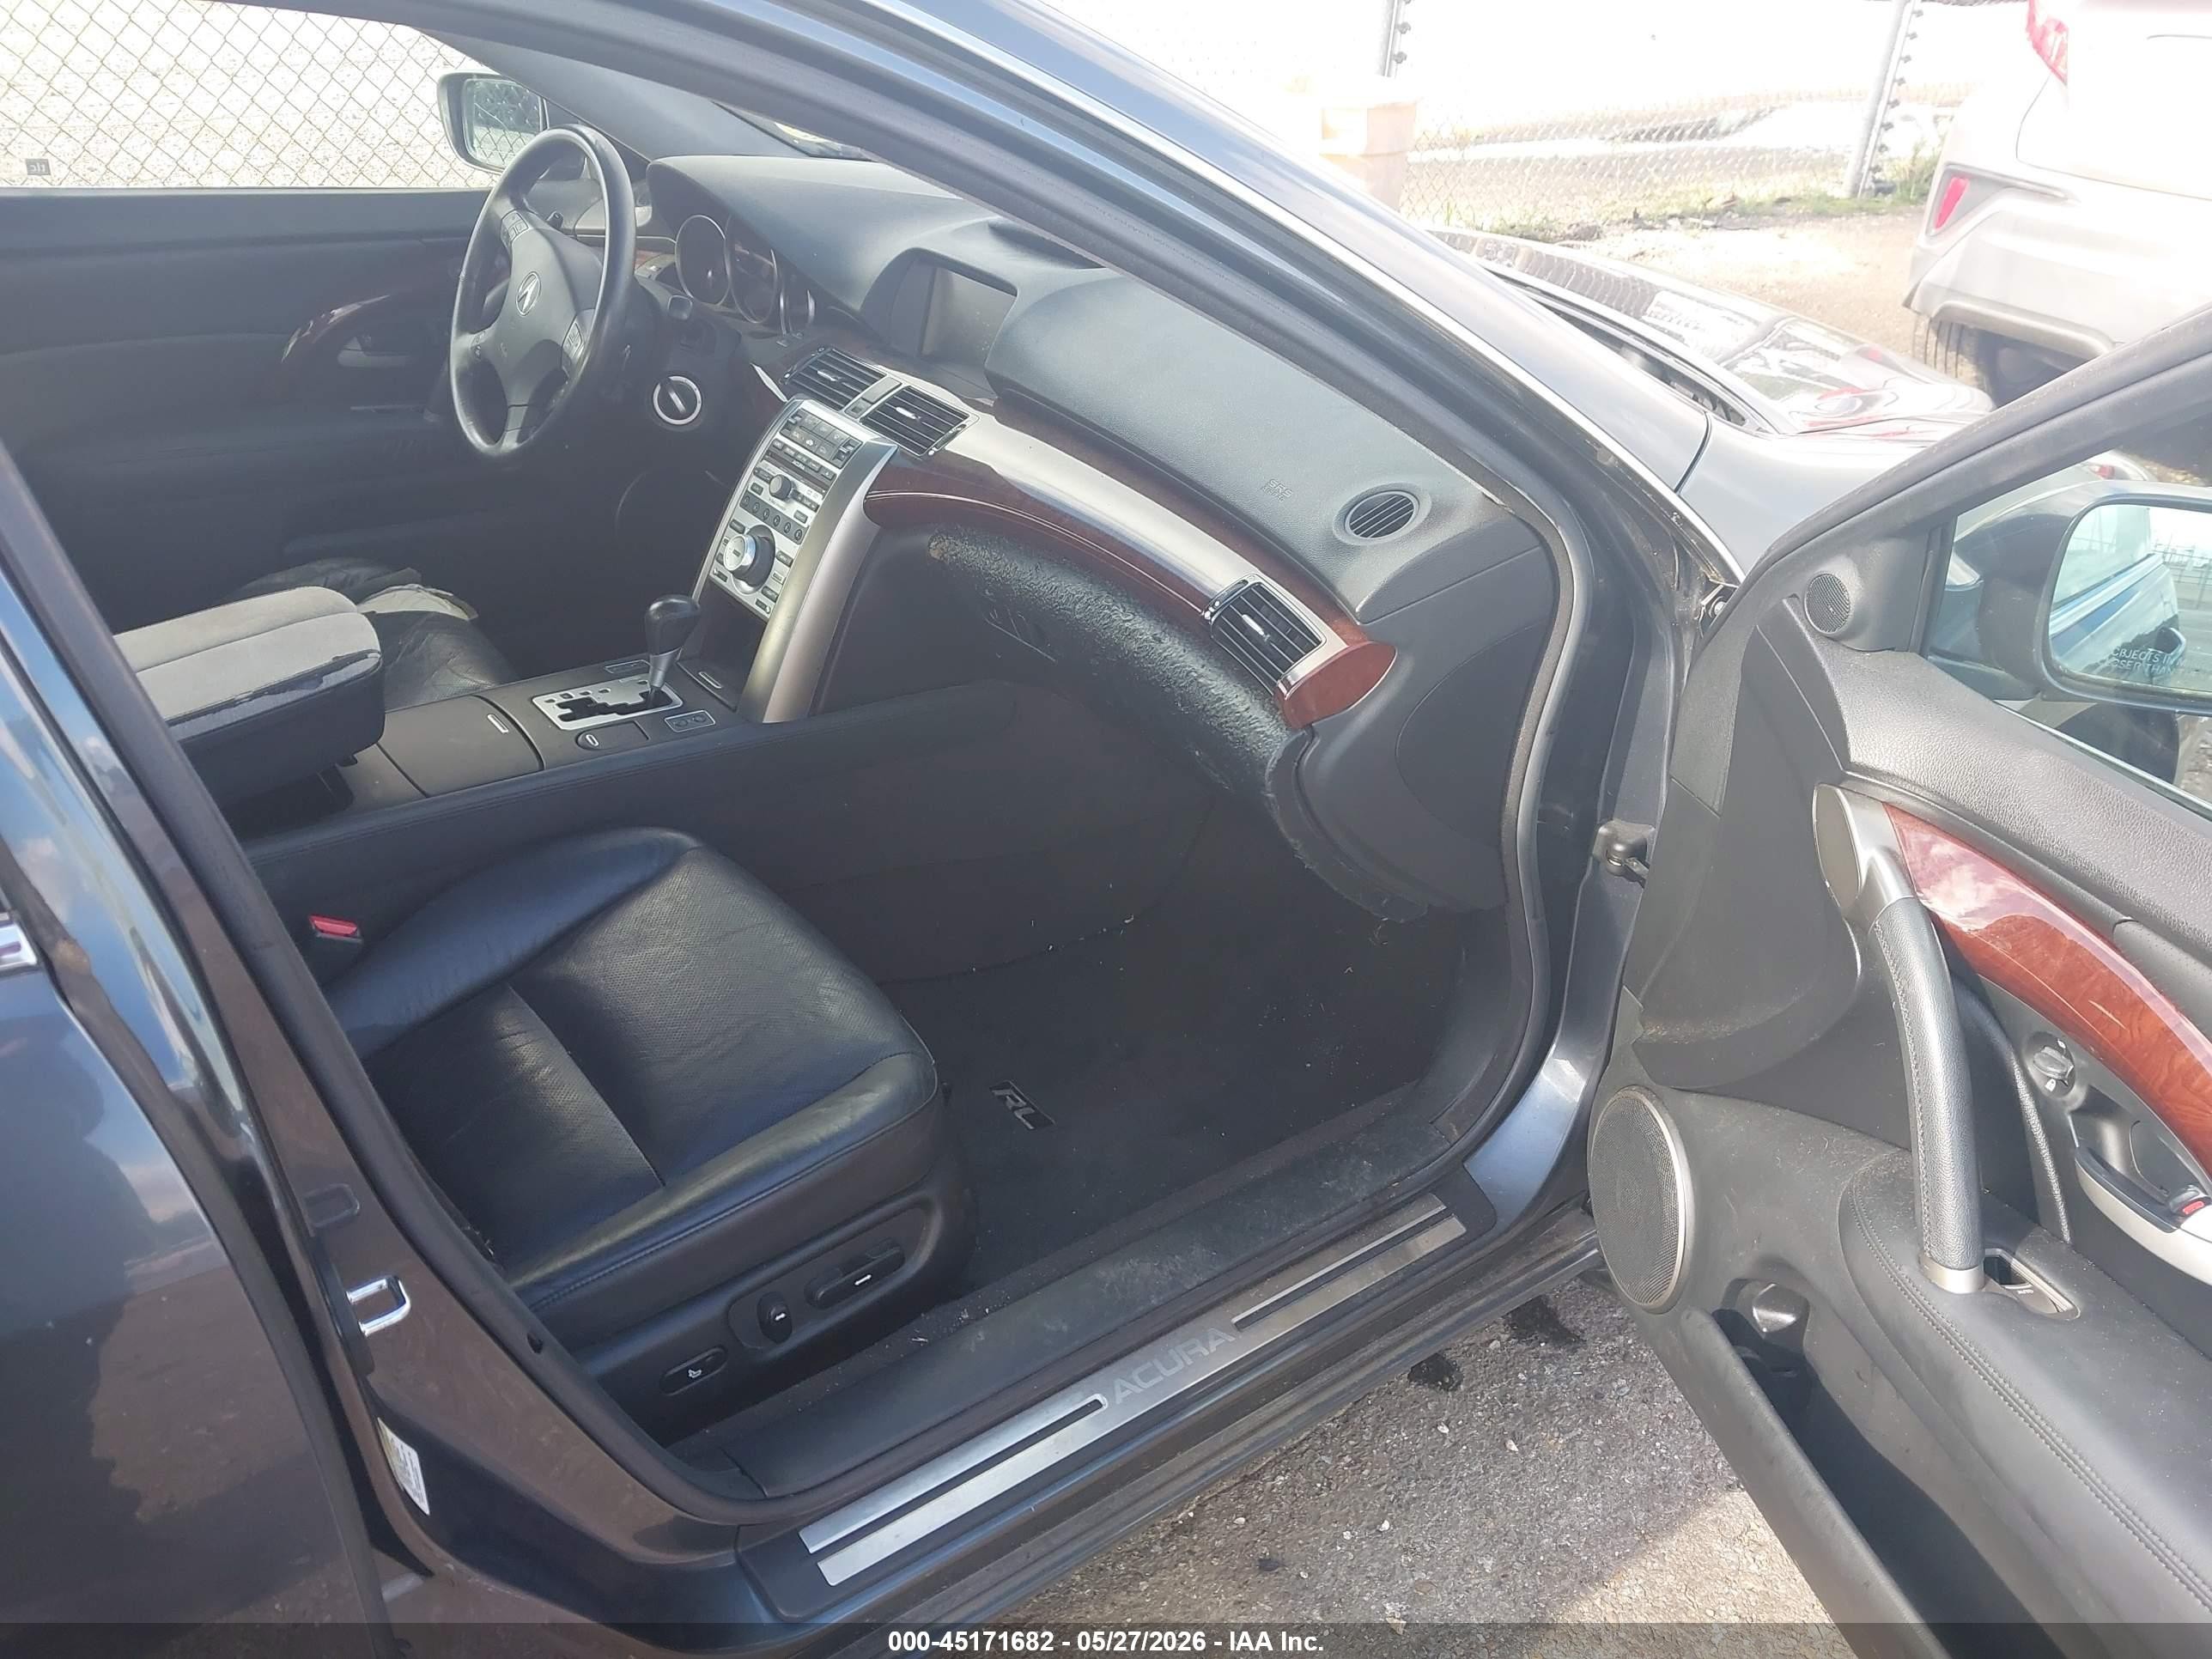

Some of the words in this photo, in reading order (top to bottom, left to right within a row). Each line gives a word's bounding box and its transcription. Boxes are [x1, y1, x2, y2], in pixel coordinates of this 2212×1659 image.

[1269, 478, 1292, 497] SRS
[991, 1088, 1036, 1131] RL
[1112, 1327, 1237, 1406] ACURA
